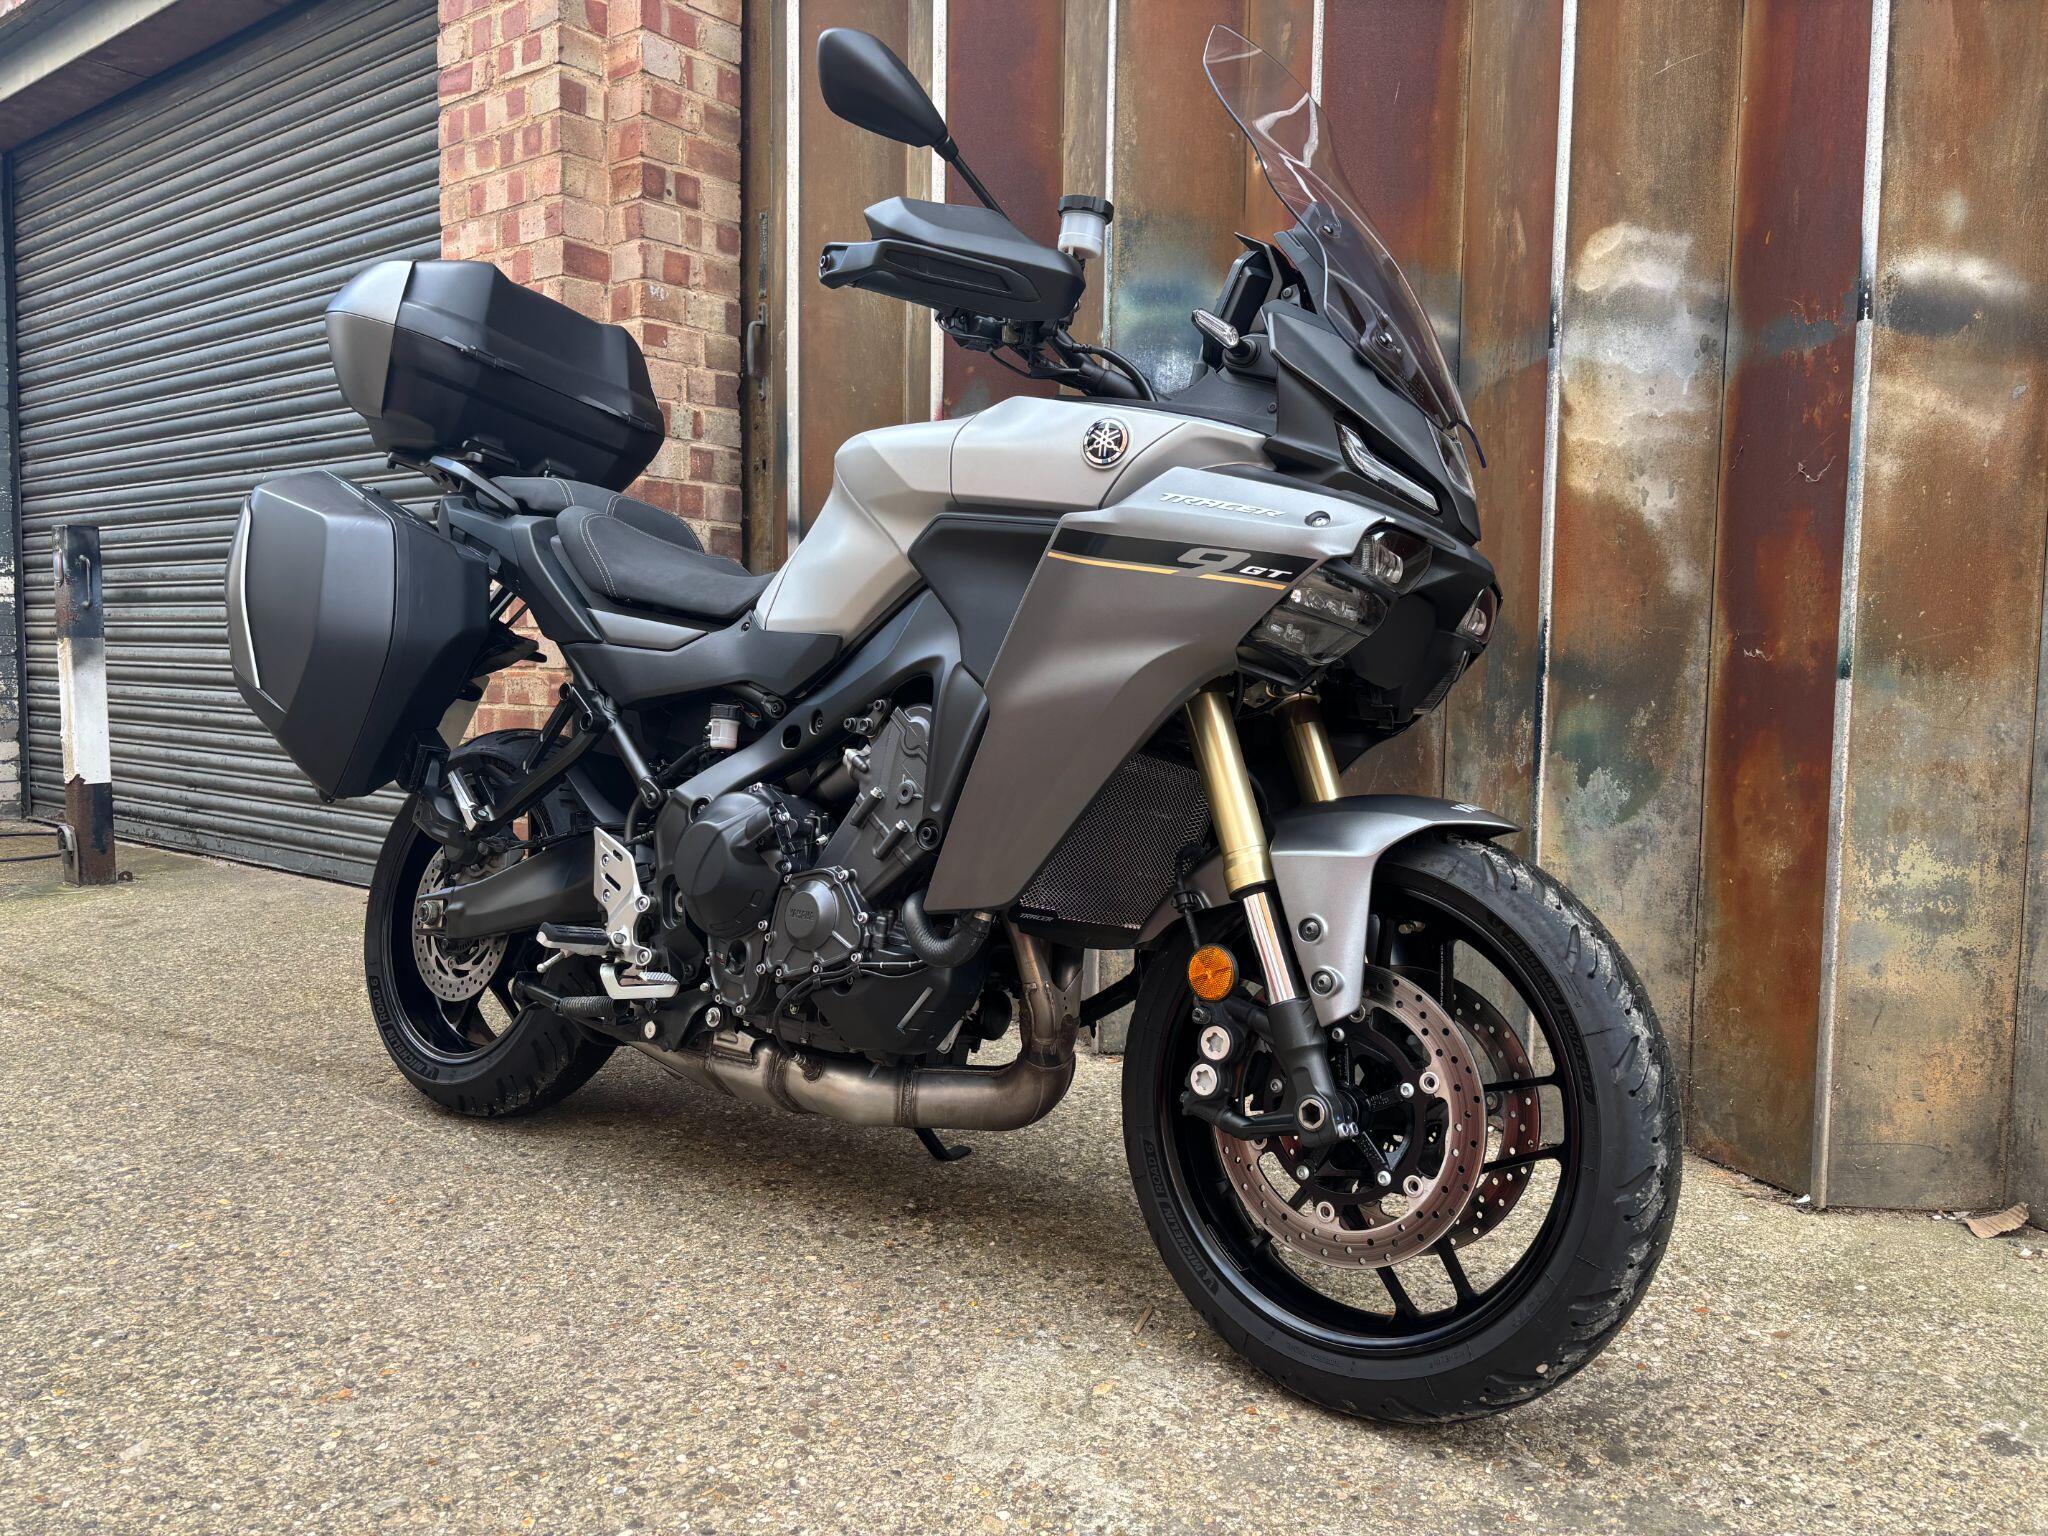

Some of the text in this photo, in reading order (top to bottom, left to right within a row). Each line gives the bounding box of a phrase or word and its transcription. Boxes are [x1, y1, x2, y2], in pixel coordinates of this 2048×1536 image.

[1160, 492, 1286, 518] TRACER
[1177, 547, 1293, 578] 9 GT
[1020, 913, 1054, 921] TRACER
[1506, 932, 1562, 1001] MICHELIN
[370, 978, 425, 1072] MICHELIN ROAD 6
[1144, 1144, 1206, 1271] MICHELIN ROAD 6
